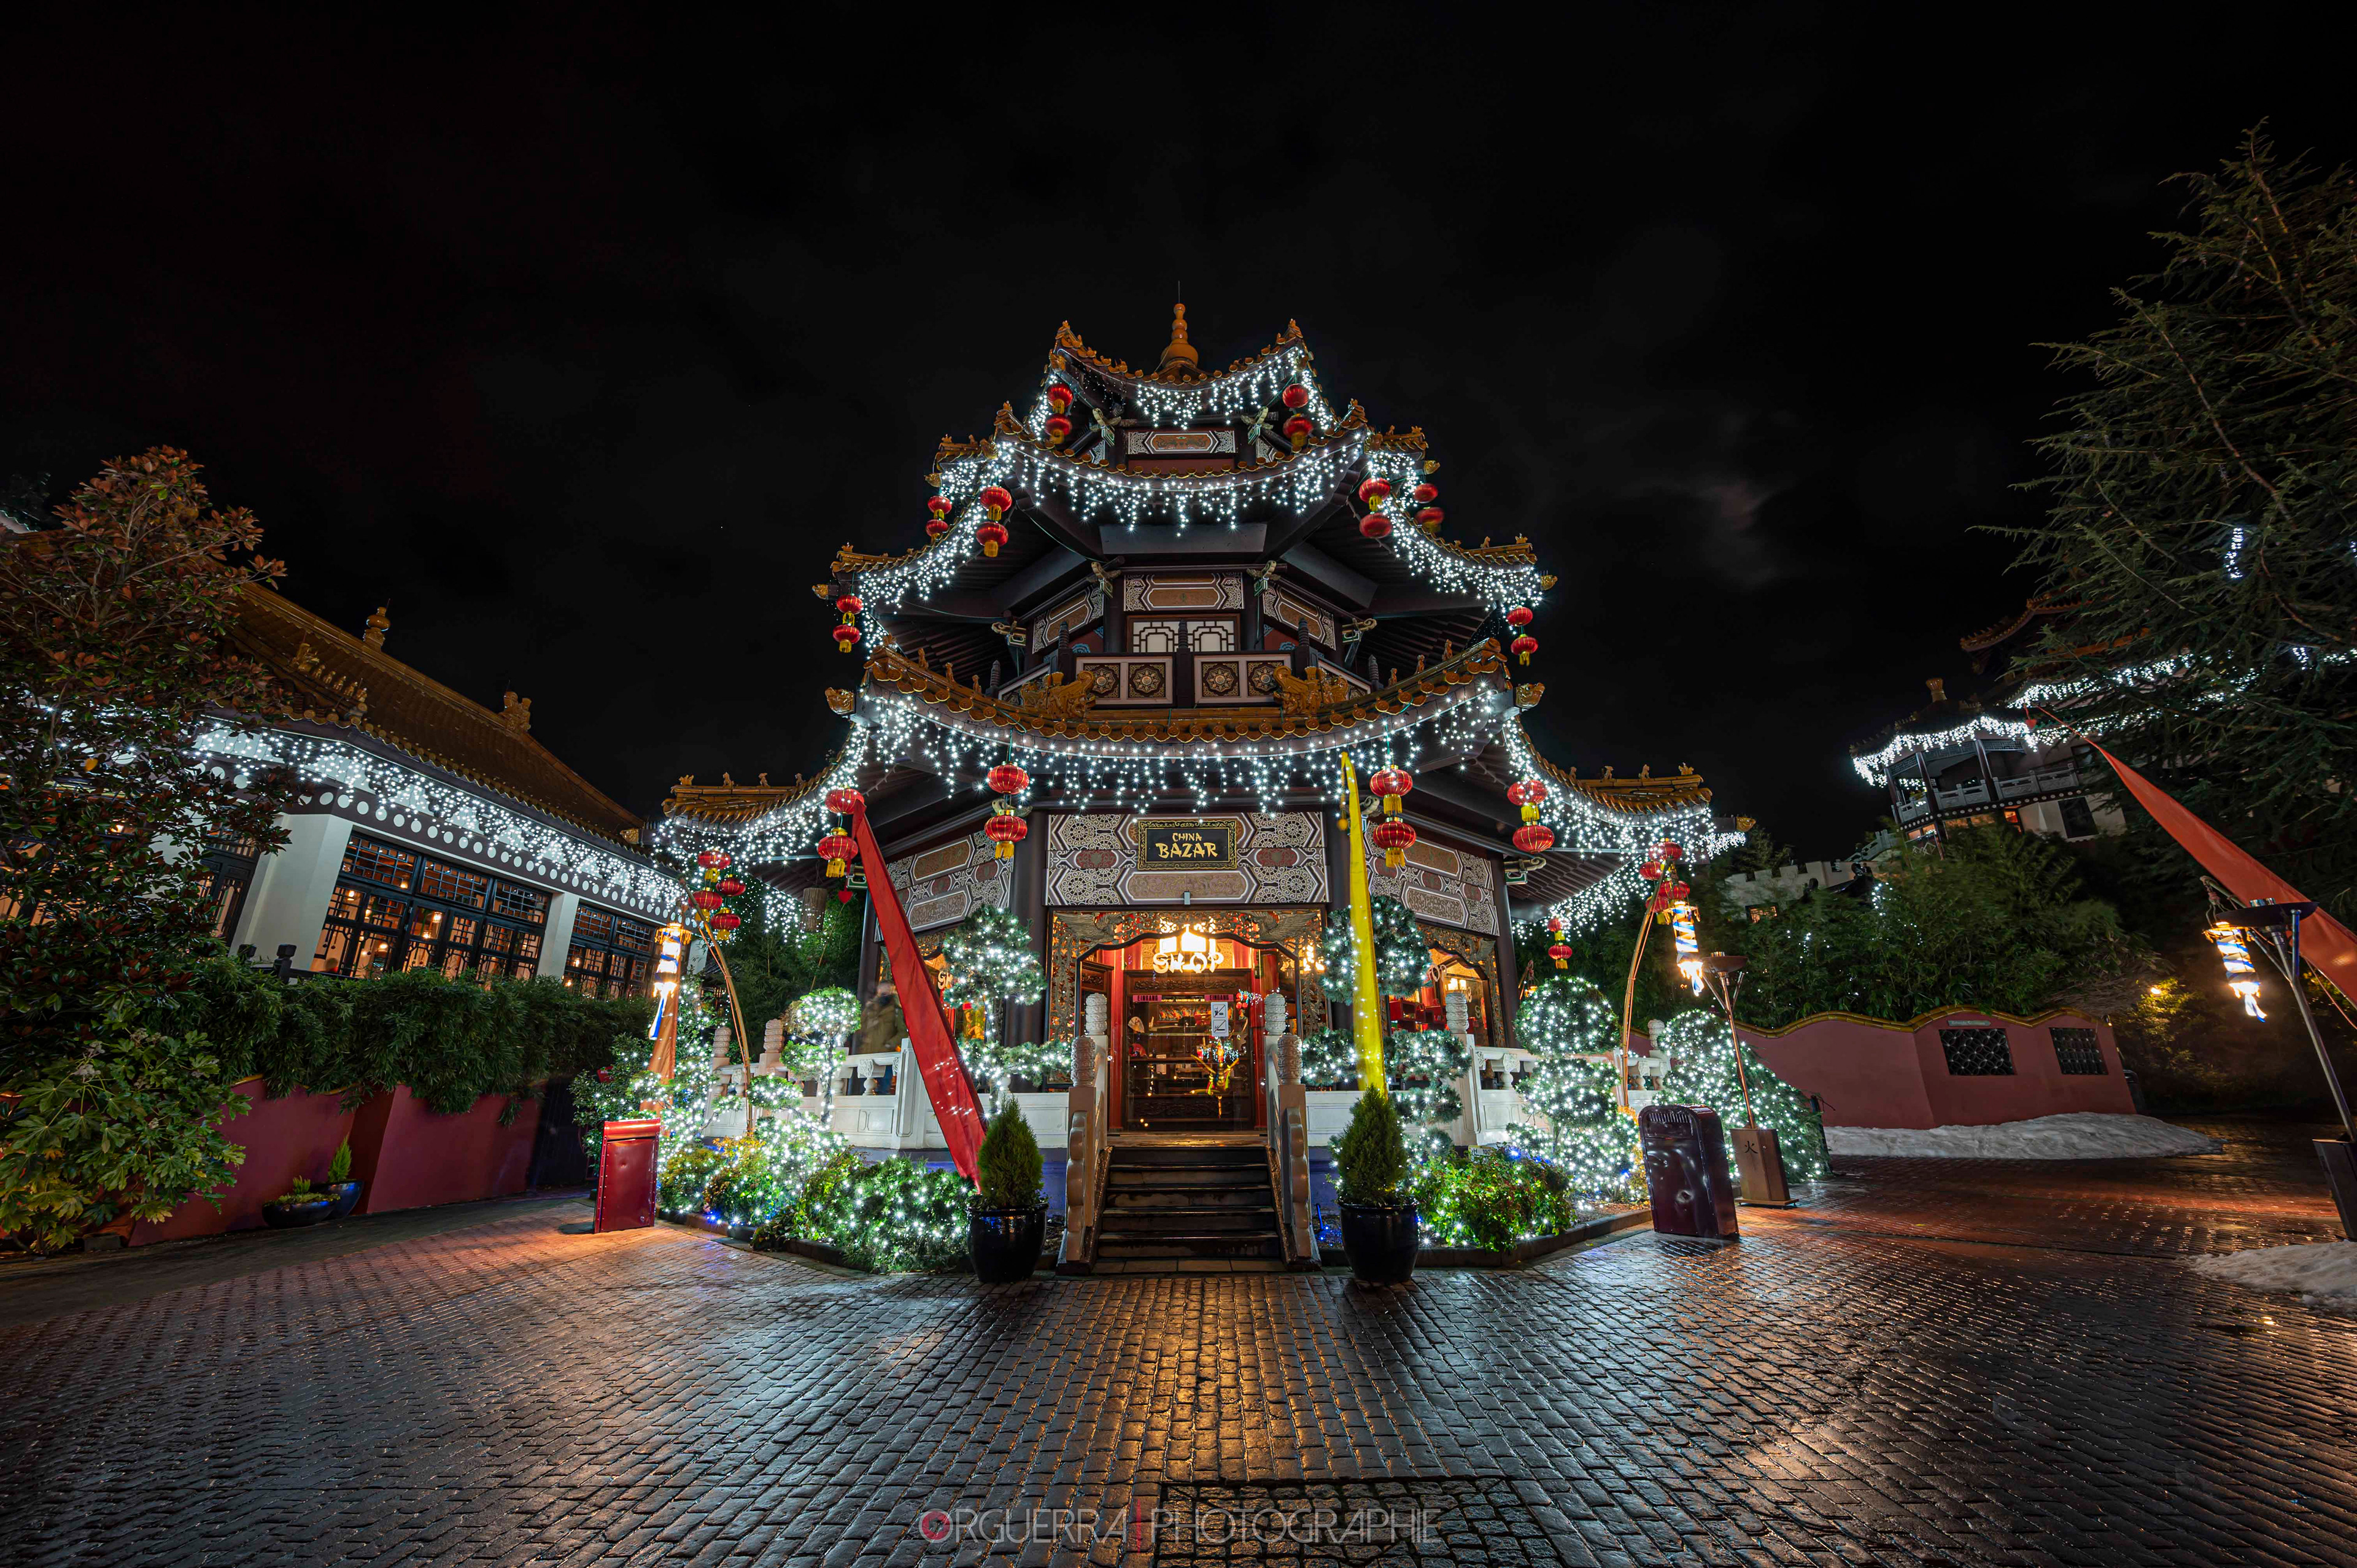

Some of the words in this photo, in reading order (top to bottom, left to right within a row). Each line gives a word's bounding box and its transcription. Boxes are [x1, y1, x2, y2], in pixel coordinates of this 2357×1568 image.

[1172, 832, 1202, 842] CHINA
[1155, 842, 1218, 859] BAZAR
[1153, 952, 1224, 973] SHOP
[1744, 1140, 1758, 1154] 火
